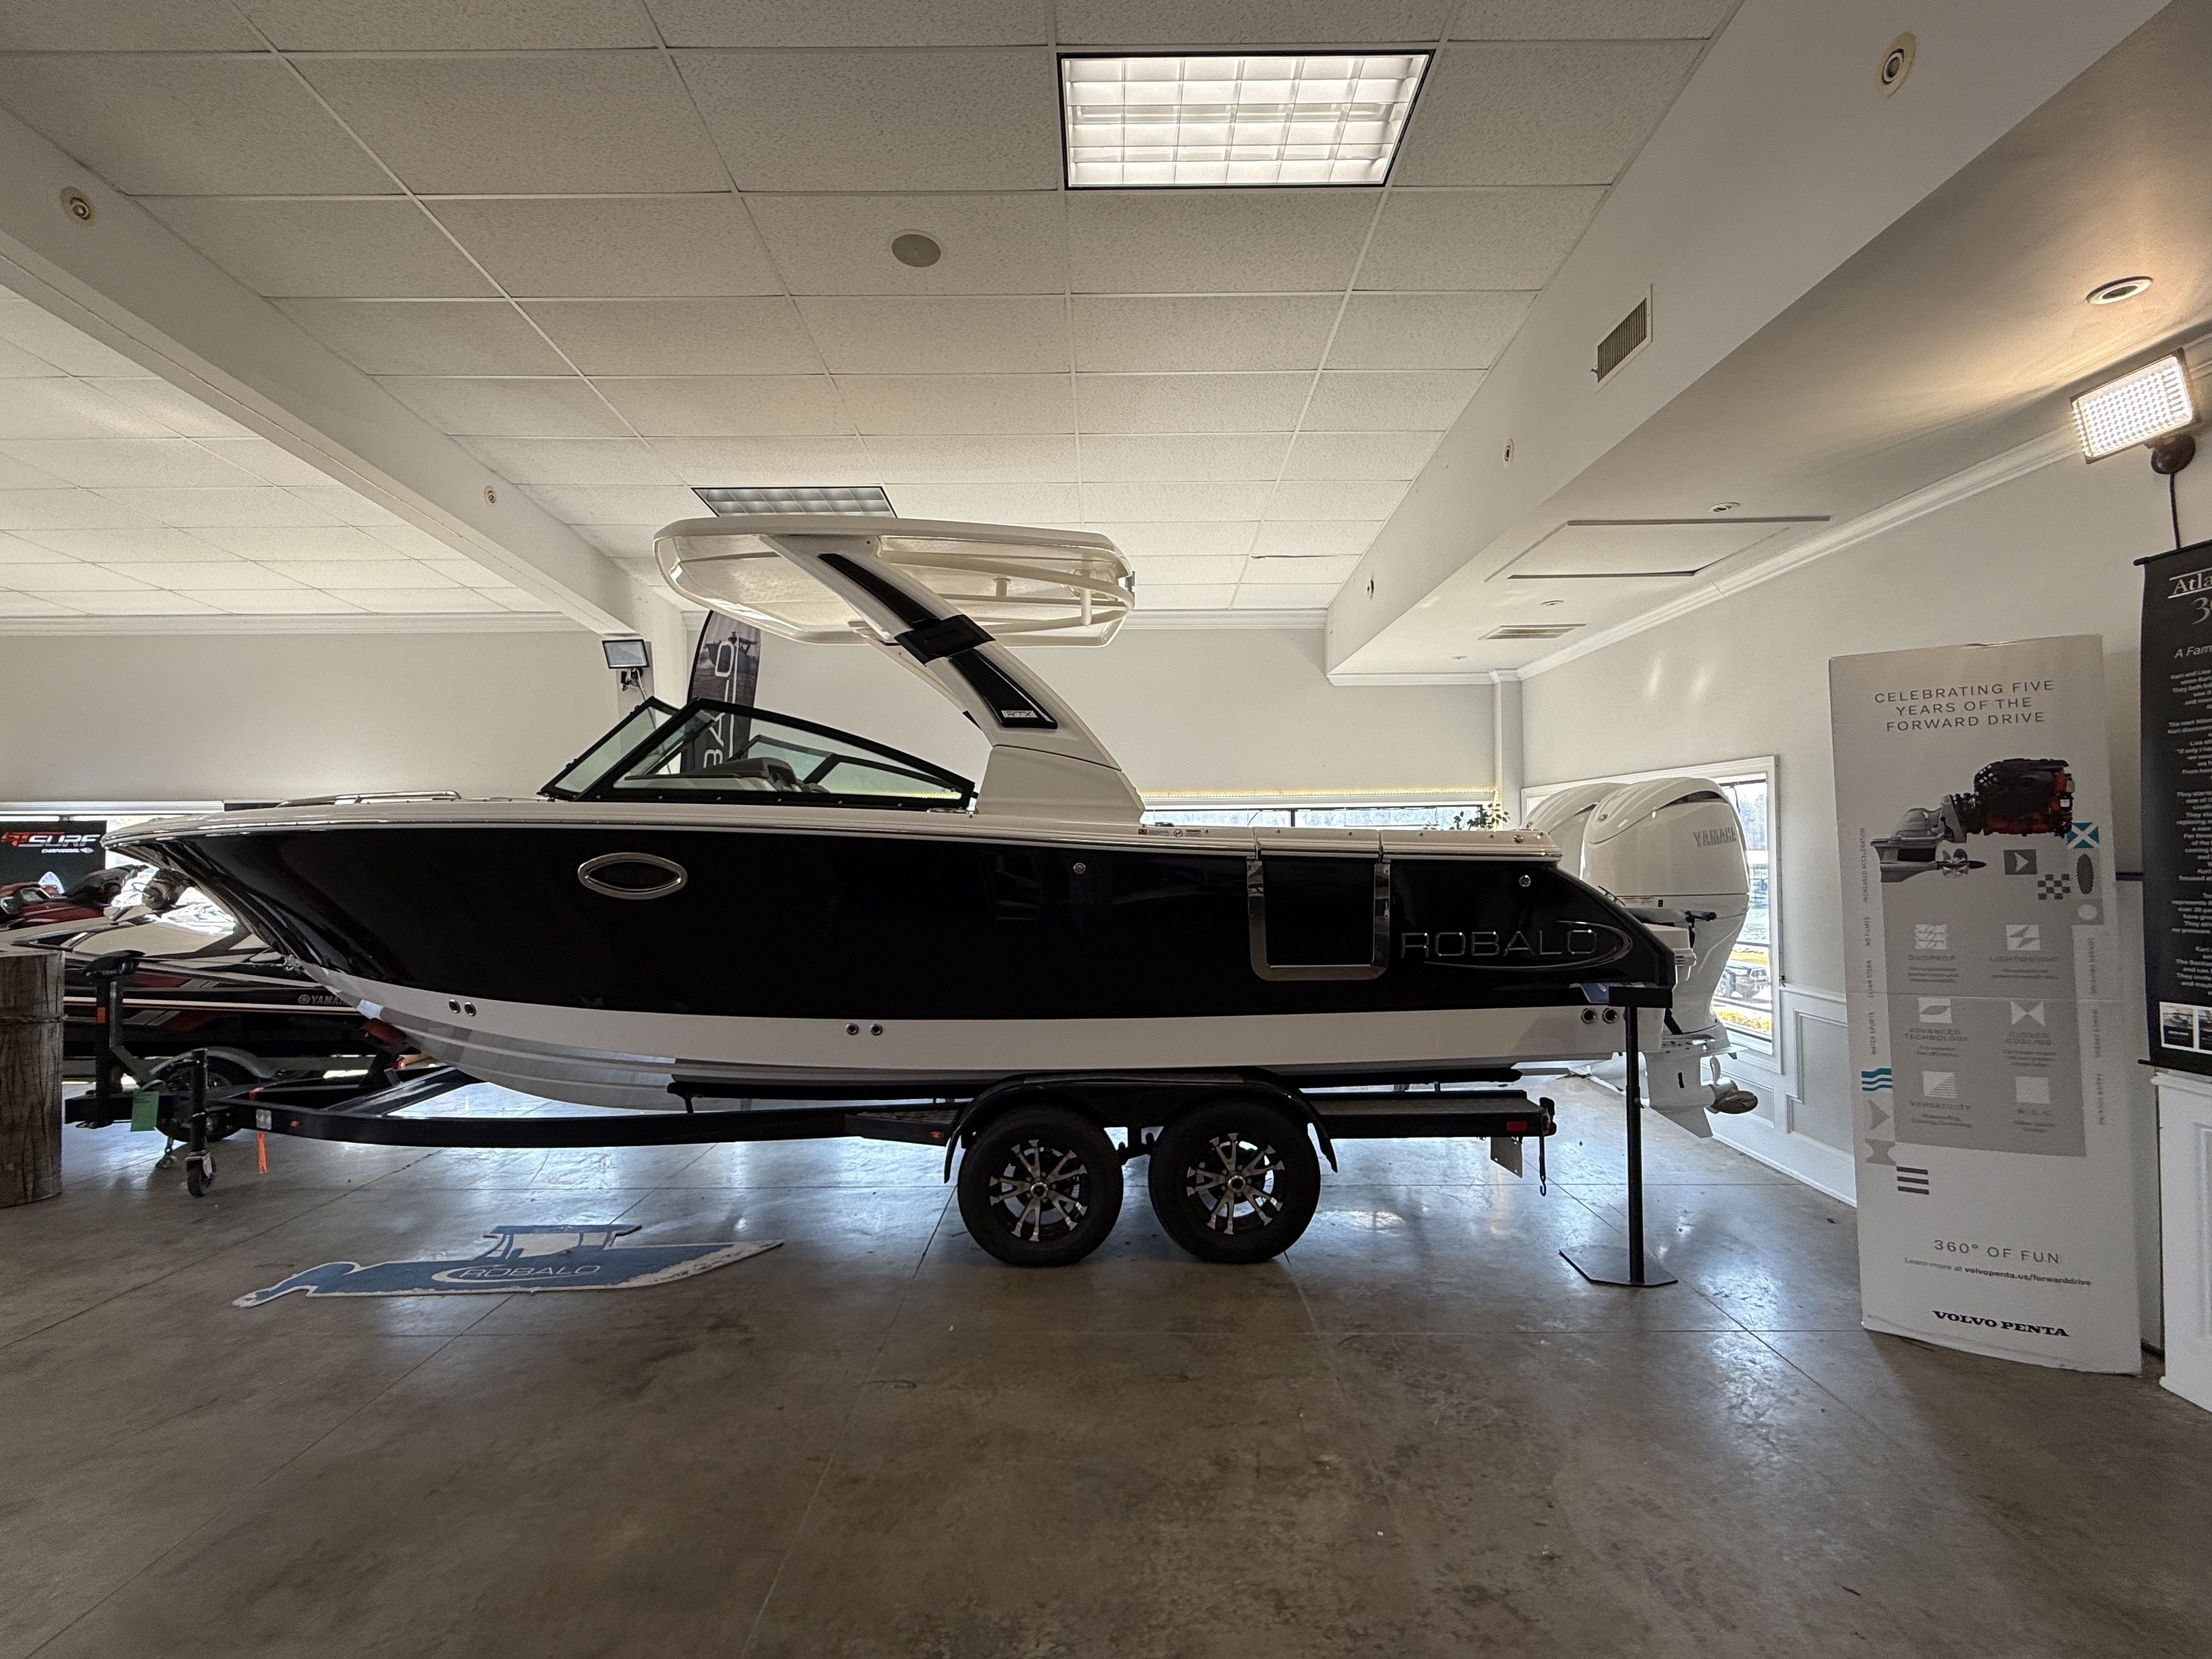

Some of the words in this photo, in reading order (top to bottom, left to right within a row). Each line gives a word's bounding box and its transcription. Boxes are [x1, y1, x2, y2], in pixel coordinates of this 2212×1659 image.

[2191, 597, 2212, 625] 3
[2174, 648, 2183, 658] A
[2186, 645, 2212, 657] Fam
[1874, 683, 2003, 703] CELEBRATING
[2012, 680, 2054, 693] FIVE
[1895, 702, 1955, 716] YEARS
[1964, 699, 1989, 712] OF
[1995, 697, 2033, 709] THE
[1886, 716, 1979, 732] FORWARD
[1988, 712, 2045, 725] DRIVE
[18, 834, 101, 848] SURF
[1400, 929, 1597, 958] ROBALO
[312, 995, 348, 1006] YAMA
[1934, 1239, 1978, 1254] 360°
[1987, 1246, 2012, 1258] OF
[2021, 1250, 2059, 1263] FUN
[459, 1265, 601, 1278] ROBALO
[1932, 1310, 1997, 1328] VOLVO
[2001, 1321, 2069, 1336] PENTA
